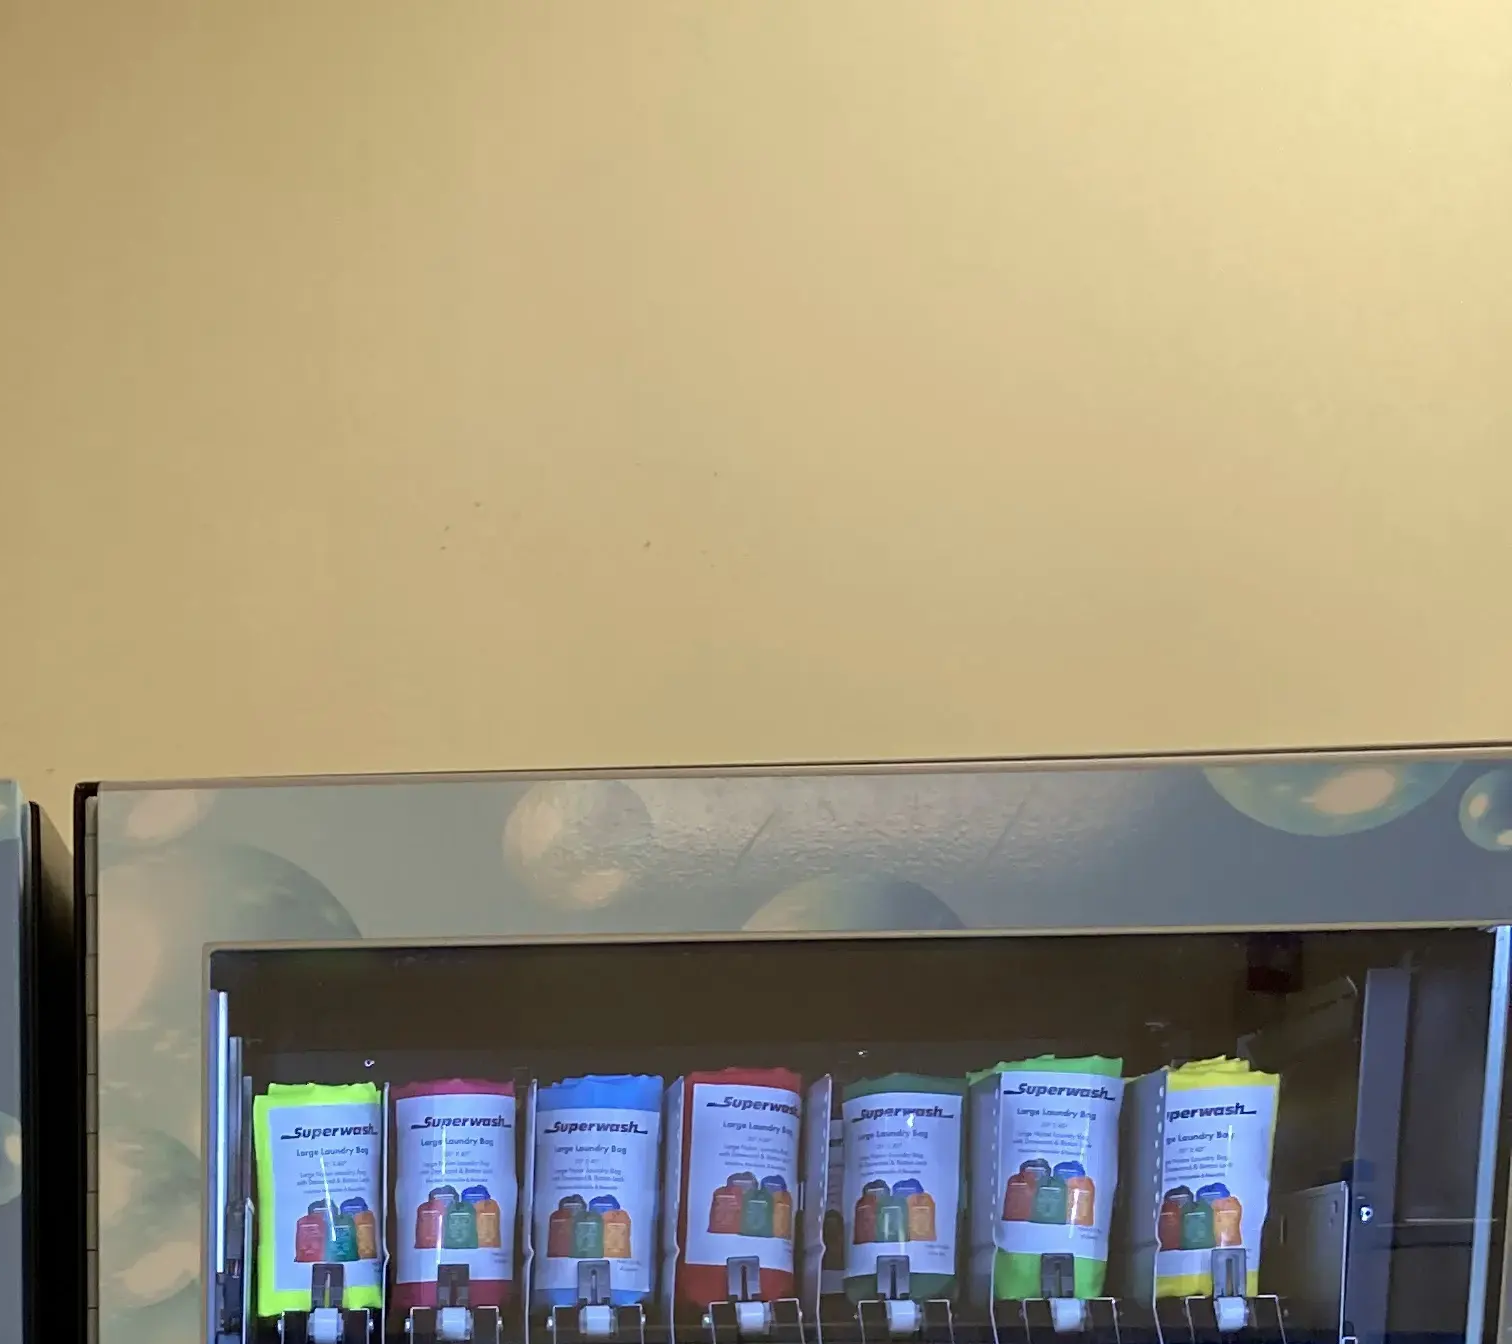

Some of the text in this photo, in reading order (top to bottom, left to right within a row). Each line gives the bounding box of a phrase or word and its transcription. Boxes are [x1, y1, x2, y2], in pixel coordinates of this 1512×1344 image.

[1003, 1083, 1116, 1101] Superwash
[411, 1115, 512, 1130] Superwash
[852, 1106, 955, 1123] Superwash
[280, 1123, 378, 1141] Superwash
[544, 1121, 648, 1136] Superwash
